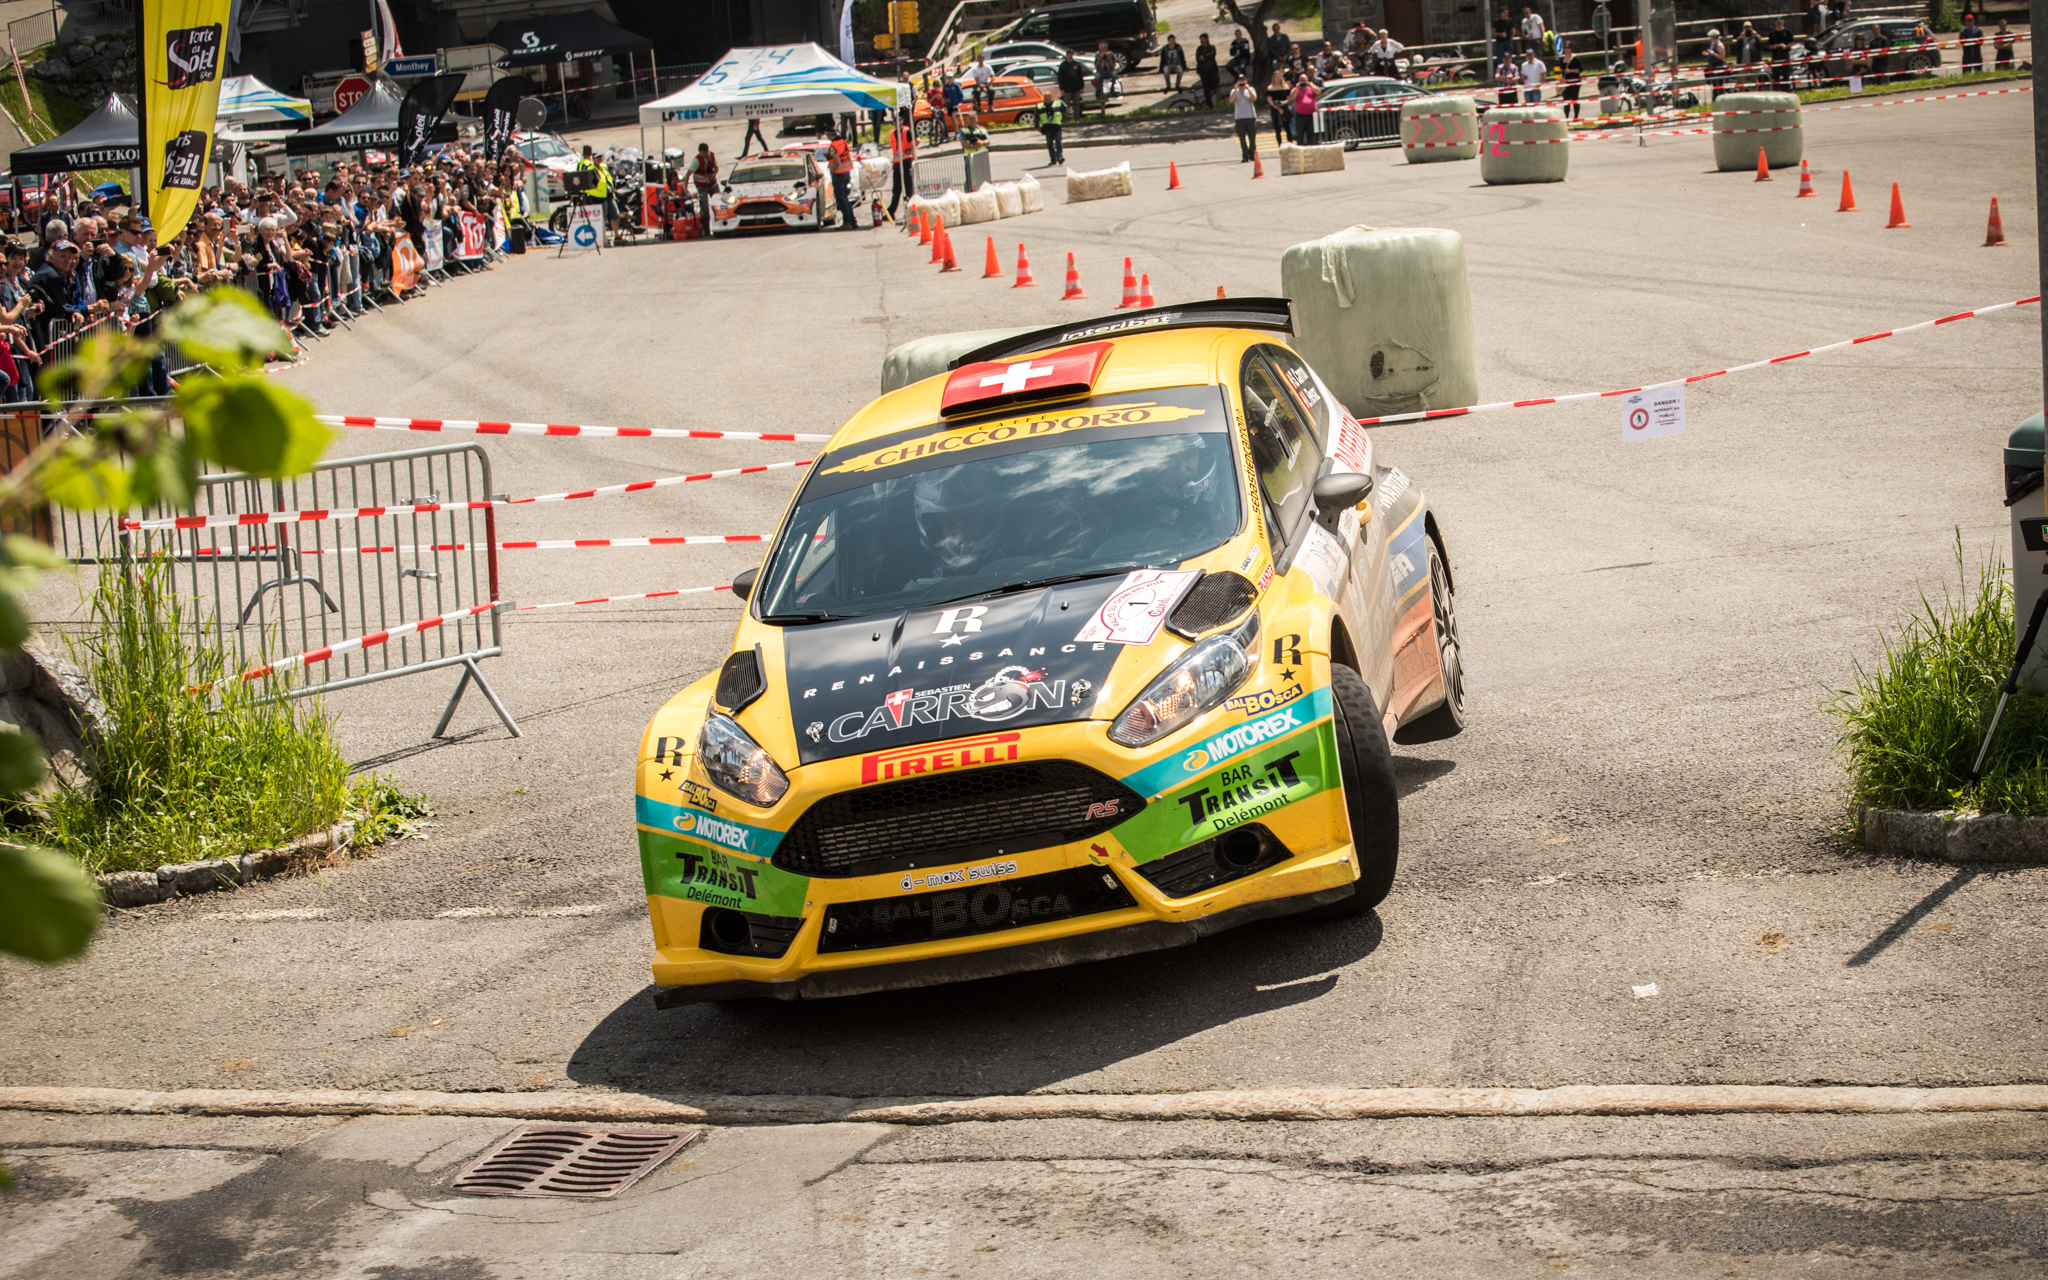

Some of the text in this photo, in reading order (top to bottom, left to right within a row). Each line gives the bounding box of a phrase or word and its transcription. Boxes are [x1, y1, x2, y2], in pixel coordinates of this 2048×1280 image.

[512, 44, 558, 55] SCOTT
[573, 49, 604, 58] SCOTT
[395, 63, 429, 72] Monthey
[339, 92, 363, 108] STO
[756, 108, 794, 116] CHAMPIONS
[408, 114, 426, 150] Soleil
[1489, 125, 1509, 156] 2
[180, 177, 197, 186] Bike
[874, 409, 1151, 466] CHICCO D'ORO
[932, 605, 989, 634] R
[1272, 633, 1303, 666] R
[803, 642, 1106, 699] RENAISSANCE
[914, 683, 972, 698] SEBASTIEN
[1206, 708, 1302, 763] MOTOREX
[654, 736, 686, 768] R
[861, 732, 1022, 785] PIRELLI
[1221, 764, 1253, 787] BAR
[1085, 799, 1120, 820] RS
[1212, 793, 1291, 832] Delémont
[696, 815, 749, 850] MOTOREX
[711, 850, 730, 869] BAR
[676, 852, 759, 900] TRANSIT
[687, 886, 742, 909] Delémont
